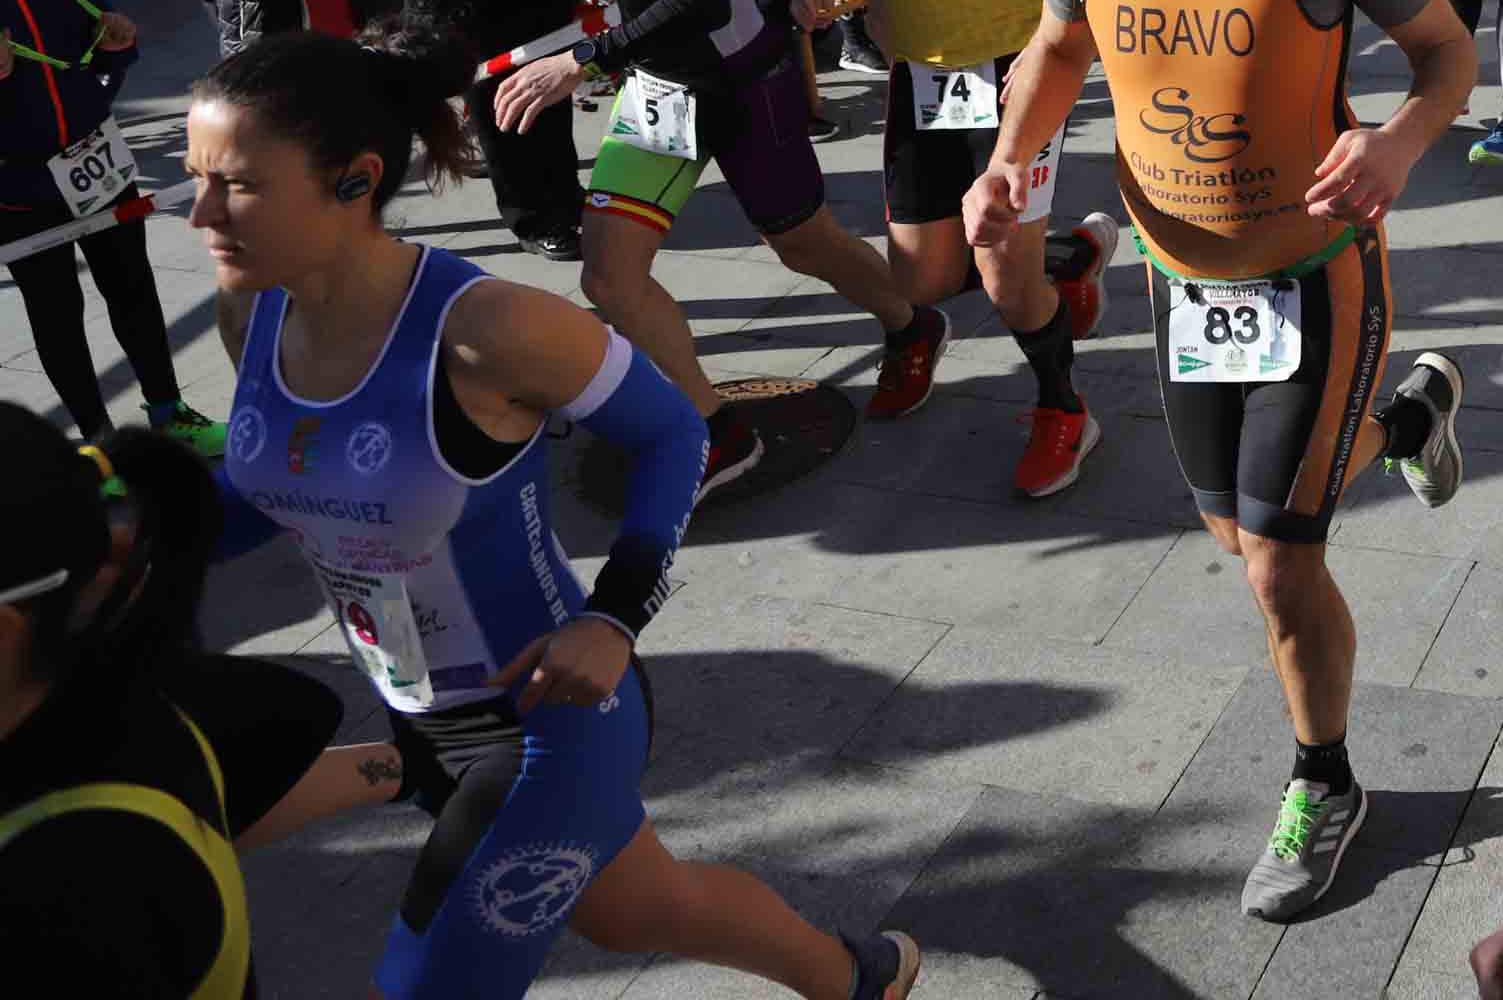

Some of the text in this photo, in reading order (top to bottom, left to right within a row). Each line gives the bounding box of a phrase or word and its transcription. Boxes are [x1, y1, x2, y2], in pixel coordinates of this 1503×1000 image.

[1115, 4, 1255, 57] BRAVO
[931, 73, 971, 103] 74
[645, 98, 660, 127] 5
[69, 141, 115, 192] 607
[1131, 152, 1165, 181] Club
[1204, 306, 1260, 344] 83
[1368, 305, 1380, 326] SyS
[1354, 335, 1379, 417] Laboratorio
[519, 481, 560, 603] CASTELLANOS
